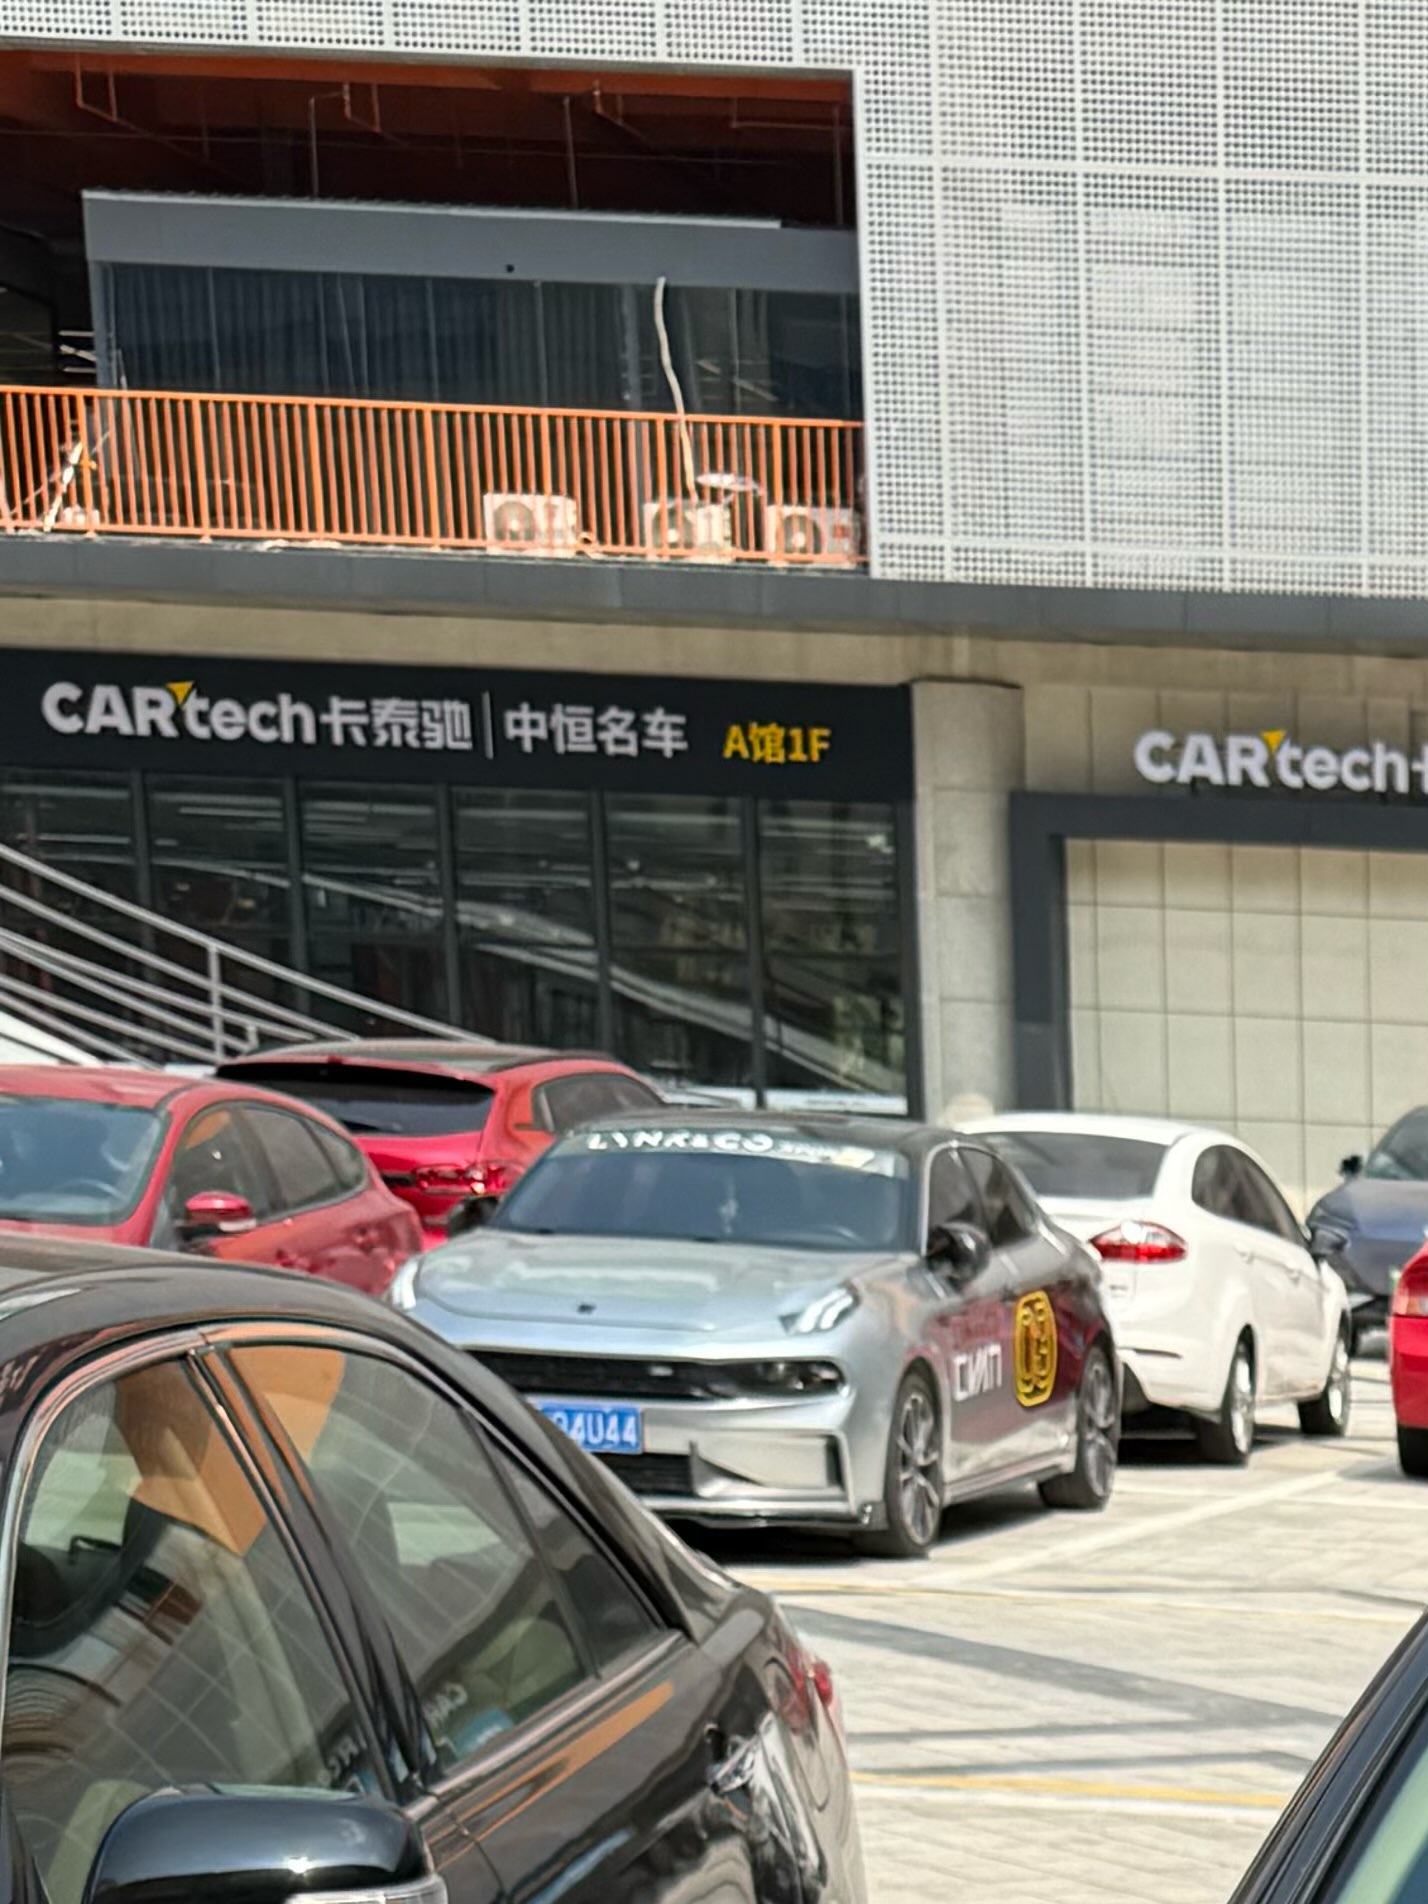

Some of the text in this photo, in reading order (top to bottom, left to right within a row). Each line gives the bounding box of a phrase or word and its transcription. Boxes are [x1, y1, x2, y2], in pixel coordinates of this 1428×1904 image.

[505, 702, 688, 760] 中恒名车
[723, 722, 831, 765] A馆1F
